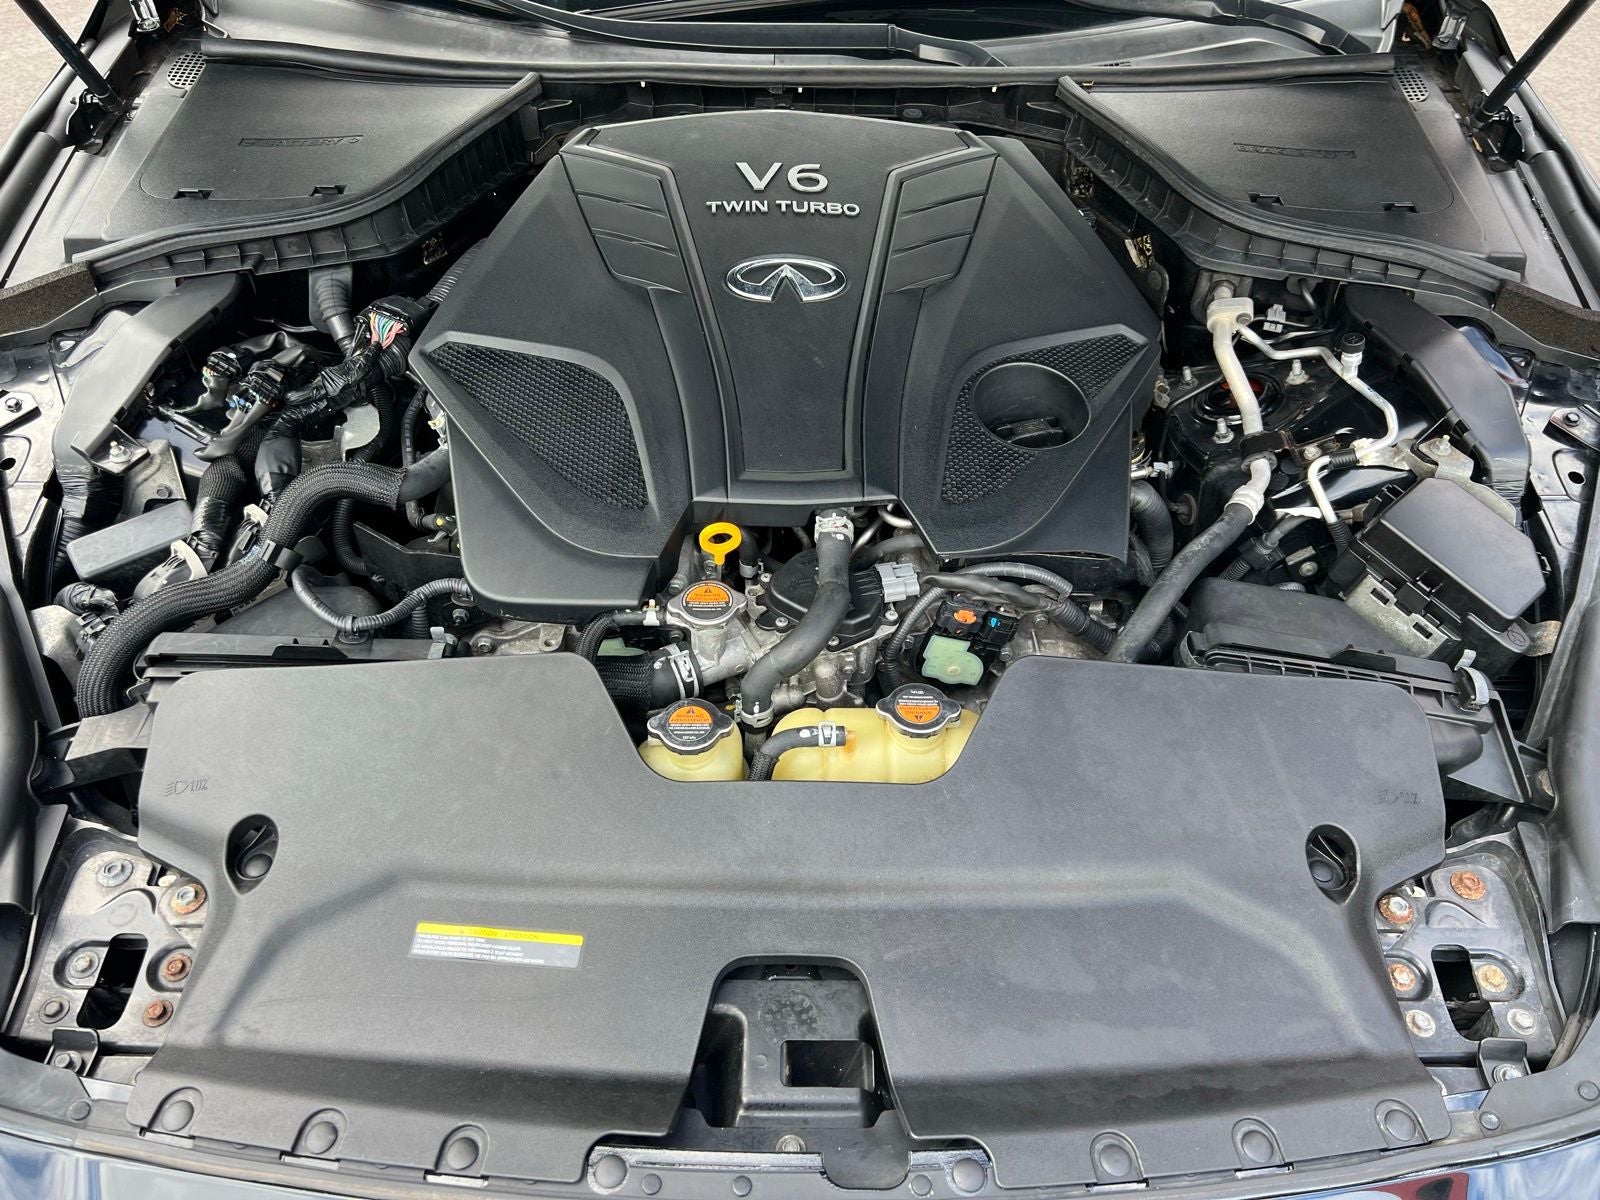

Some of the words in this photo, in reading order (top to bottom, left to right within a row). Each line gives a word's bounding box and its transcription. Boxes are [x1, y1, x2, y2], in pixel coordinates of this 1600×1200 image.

[735, 162, 829, 193] V6
[706, 200, 769, 214] TWIN
[776, 200, 860, 217] TURBO
[468, 928, 498, 937] CAUTION
